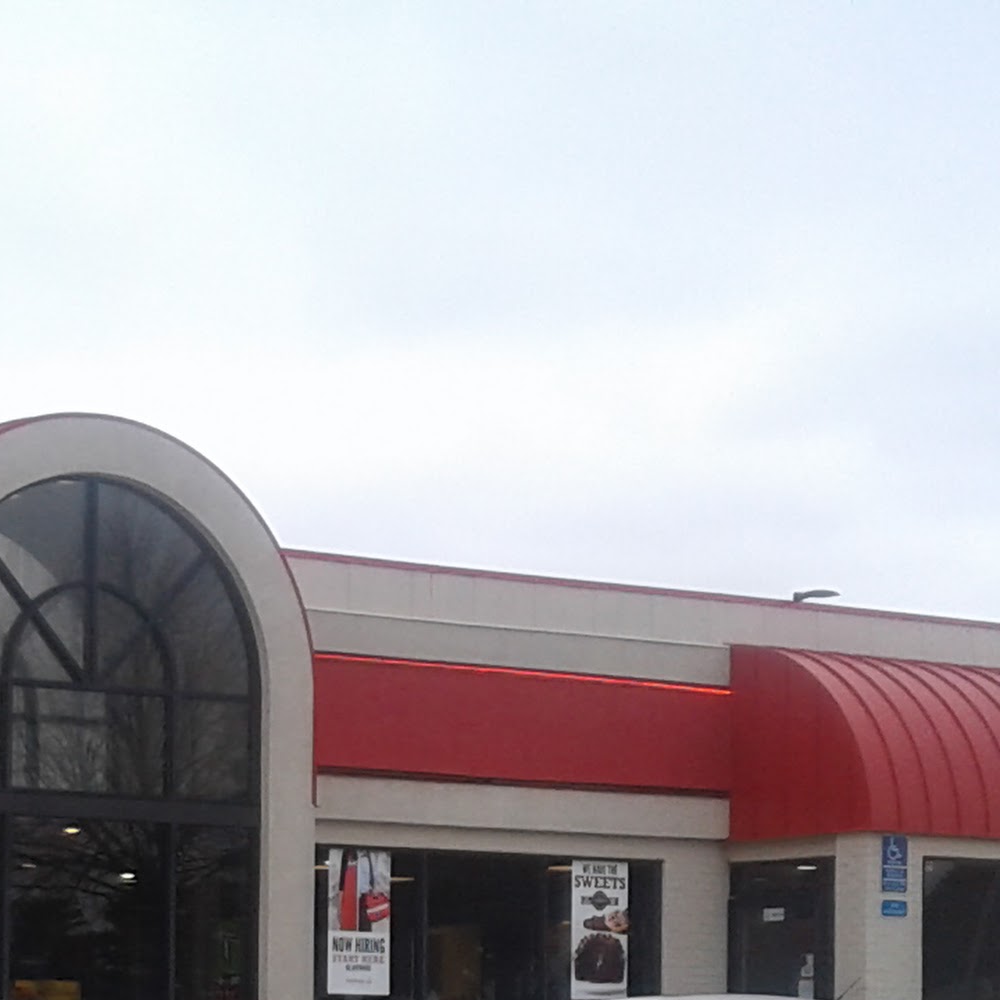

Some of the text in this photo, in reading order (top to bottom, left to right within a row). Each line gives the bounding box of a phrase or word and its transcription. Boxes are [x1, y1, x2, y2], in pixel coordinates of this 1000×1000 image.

[574, 875, 626, 889] SWEETS
[332, 936, 386, 954] NOW HIRING
